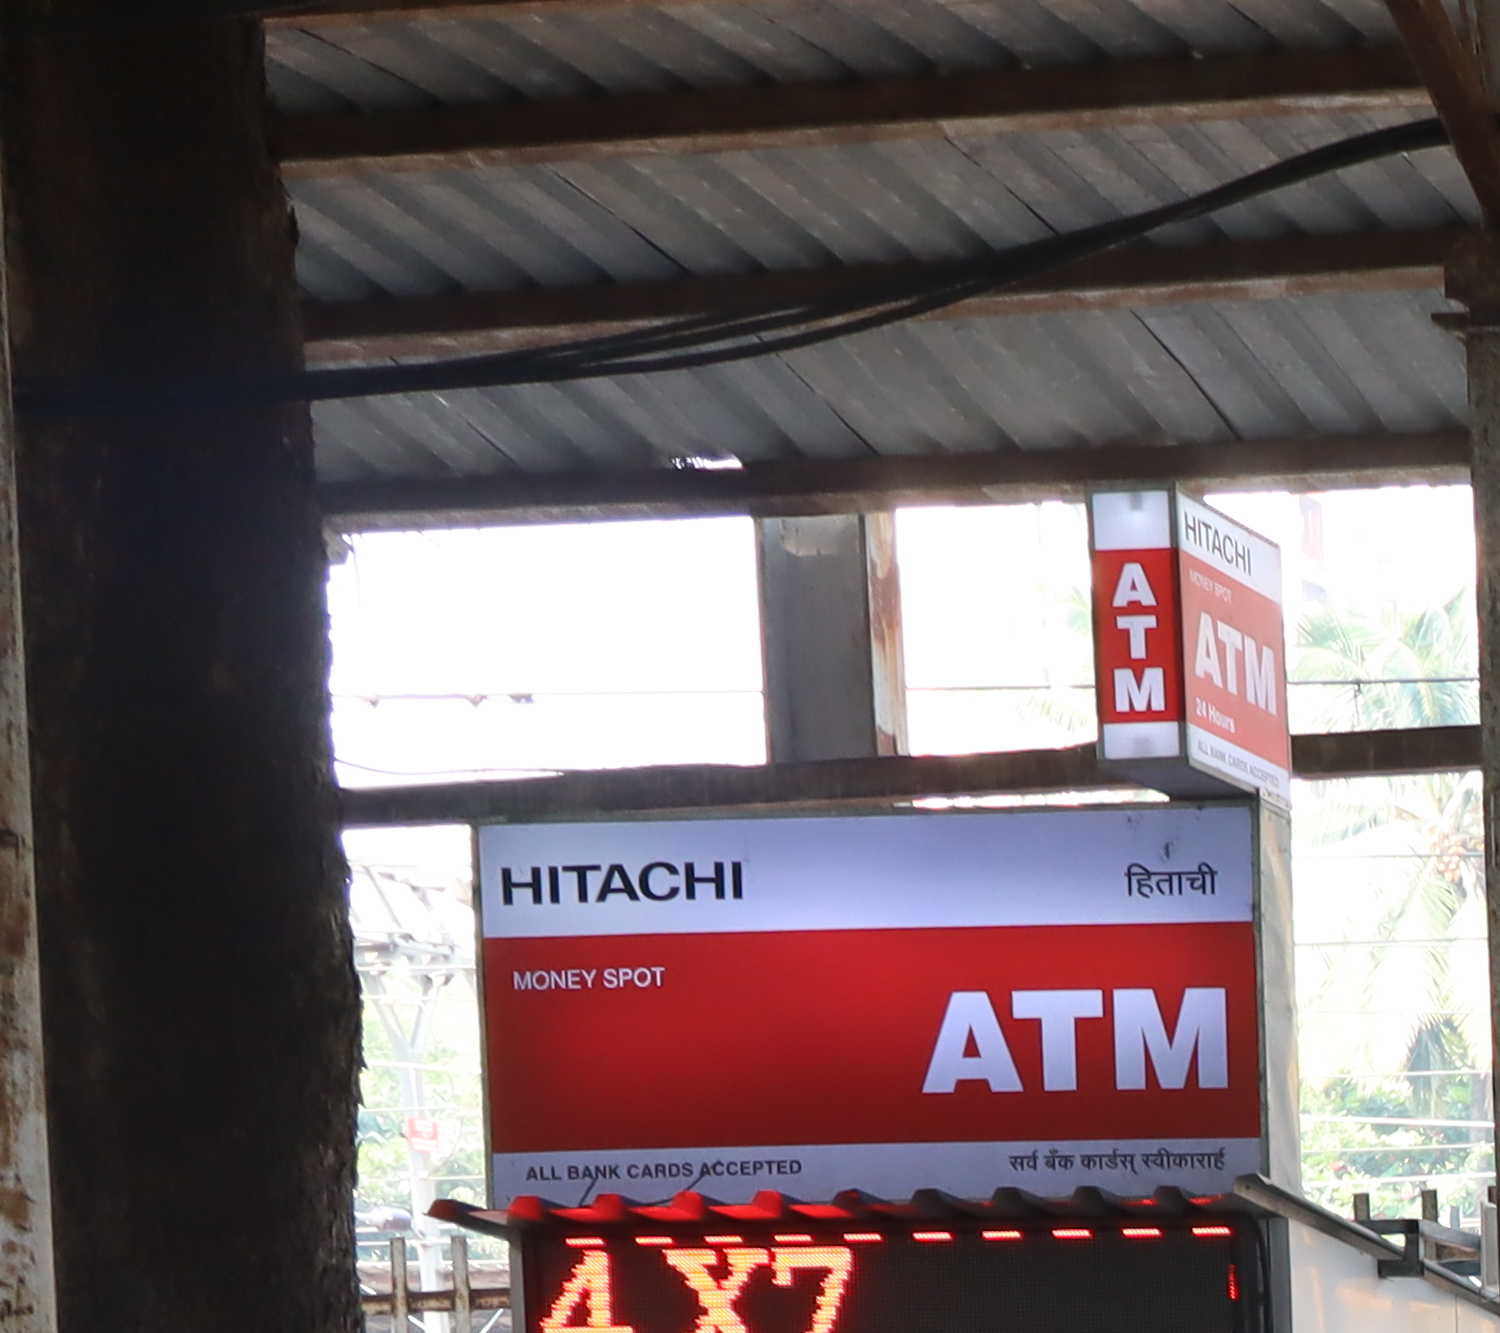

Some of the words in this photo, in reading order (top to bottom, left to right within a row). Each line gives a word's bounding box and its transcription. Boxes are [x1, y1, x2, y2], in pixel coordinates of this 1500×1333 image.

[1183, 511, 1252, 577] HITACHI
[1112, 561, 1166, 714] ATM
[1195, 611, 1278, 716] ATM
[1196, 698, 1208, 718] 24
[1209, 703, 1236, 735] Hours
[500, 861, 744, 906] HITACHI
[1124, 861, 1218, 899] हिताची
[513, 969, 597, 991] MONEY
[603, 966, 666, 989] SPOT
[922, 987, 1229, 1094] ATM
[526, 1167, 562, 1182] ALL
[567, 1164, 621, 1181] BANK
[627, 1162, 694, 1179] CARDS
[700, 1159, 803, 1177] ACCEPTED
[1009, 1149, 1039, 1172] सर्व
[1080, 1148, 1138, 1176] कार्डस्
[1141, 1147, 1226, 1172] स्वीकारार्ह
